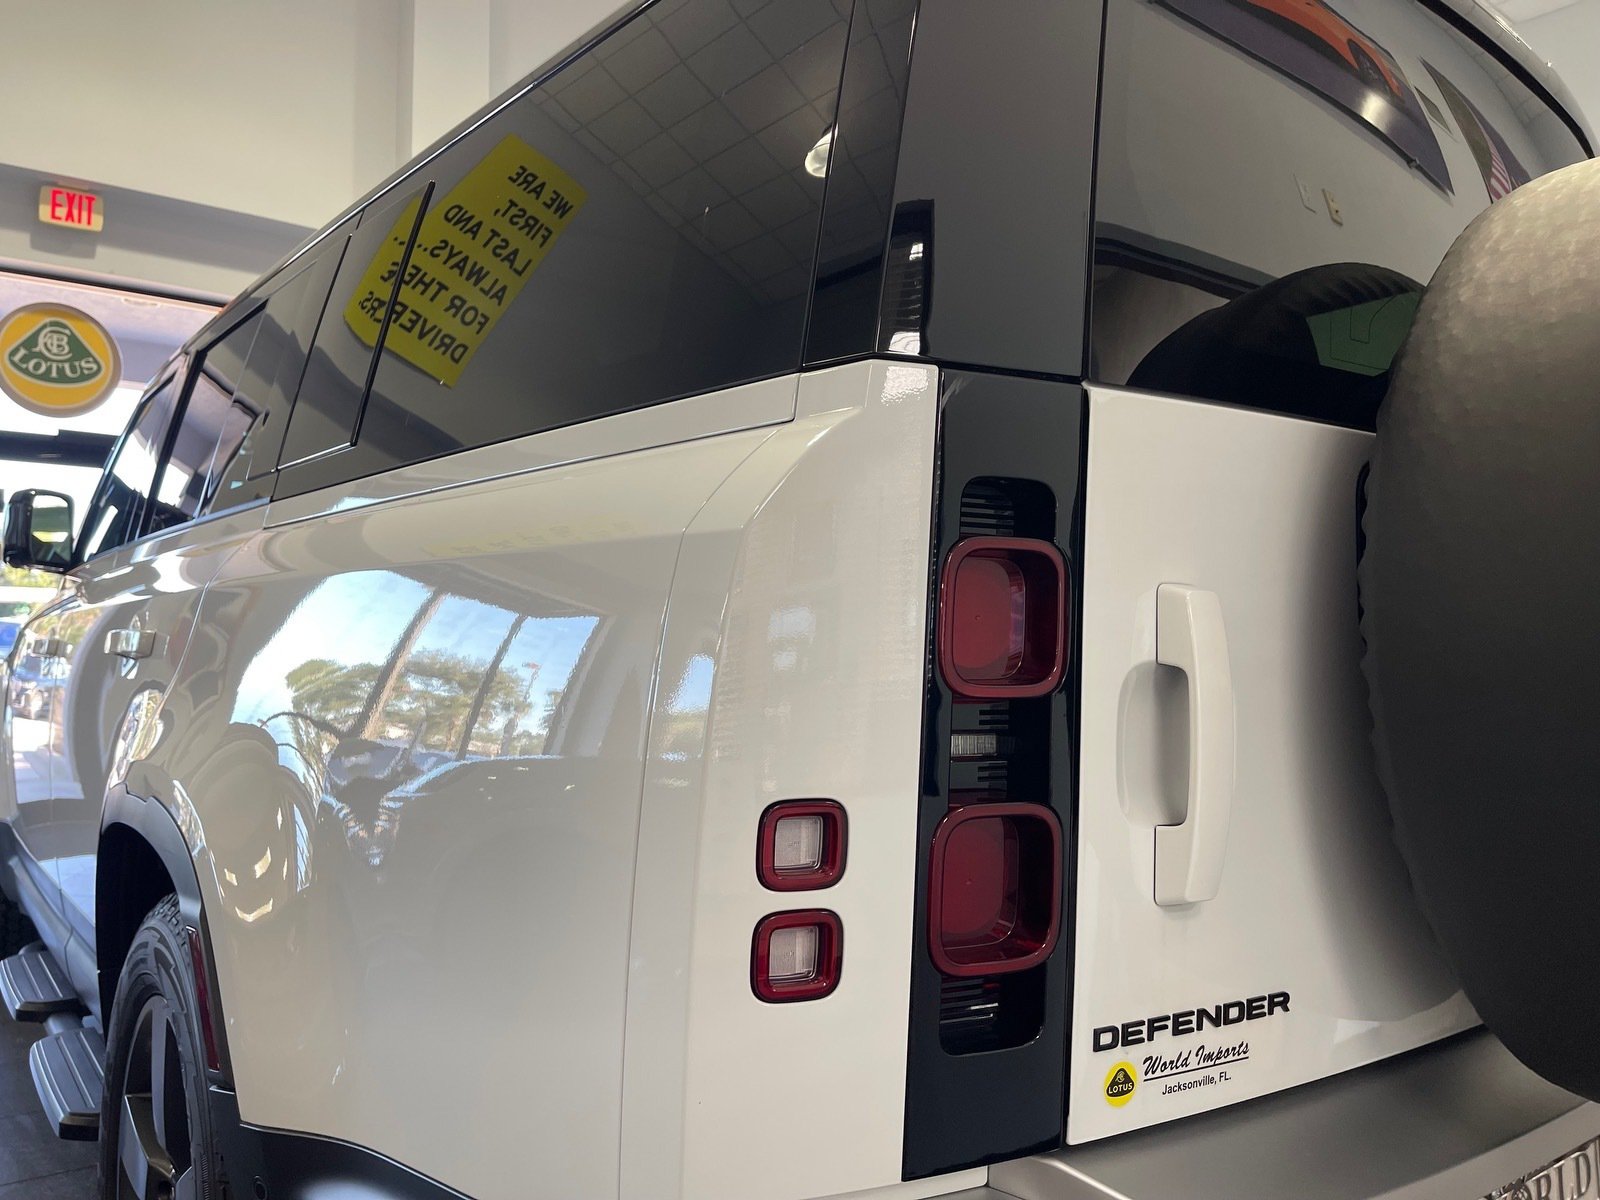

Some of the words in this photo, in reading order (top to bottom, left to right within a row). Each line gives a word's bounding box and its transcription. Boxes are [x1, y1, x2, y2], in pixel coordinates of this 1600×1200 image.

[51, 189, 96, 226] EXIT
[11, 348, 98, 378] LOTUS
[1093, 991, 1290, 1052] DEFENDER
[1142, 1051, 1190, 1077] World
[1195, 1041, 1249, 1066] Imports
[1108, 1082, 1133, 1094] LOTUS
[1162, 1076, 1217, 1095] Jacksonville,
[1219, 1071, 1232, 1083] FL.
